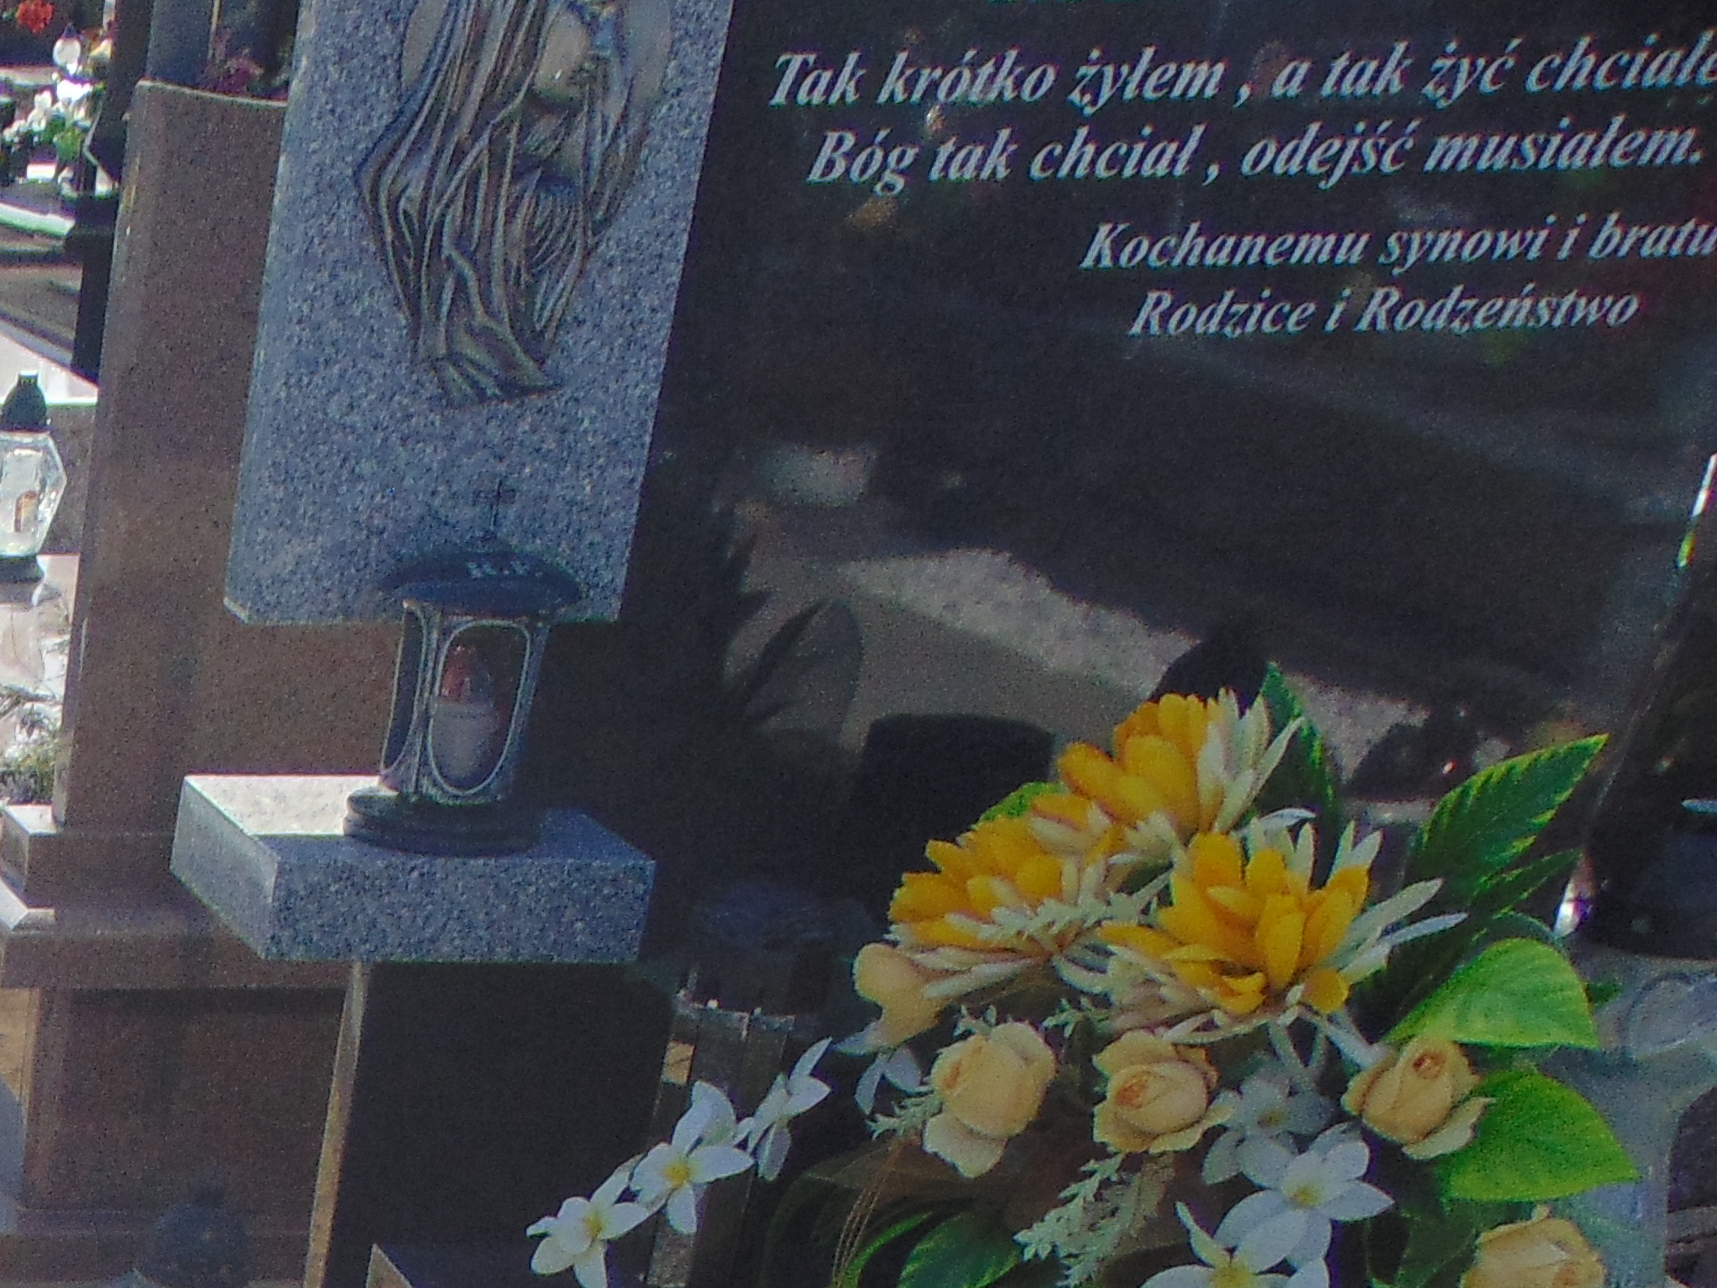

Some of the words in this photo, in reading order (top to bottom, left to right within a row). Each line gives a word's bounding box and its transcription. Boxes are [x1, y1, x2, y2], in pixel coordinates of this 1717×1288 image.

[768, 48, 867, 107] Tak
[877, 44, 1059, 106] krótko
[1270, 57, 1312, 98] a
[1320, 39, 1415, 98] tak
[1421, 37, 1524, 110] żyć
[805, 127, 919, 198] Bóg
[927, 125, 1019, 183] tak
[1028, 120, 1208, 182] chciał
[1239, 117, 1423, 191] odejść
[1423, 113, 1705, 173] musiałem.
[1078, 220, 1371, 269] Kochanemu
[1378, 213, 1559, 277] synowi
[1557, 213, 1588, 262] i
[1588, 210, 1717, 262] bratu
[1127, 288, 1318, 338] Rodzice
[1324, 287, 1353, 334] i
[1353, 282, 1642, 335] Rodzeństwo
